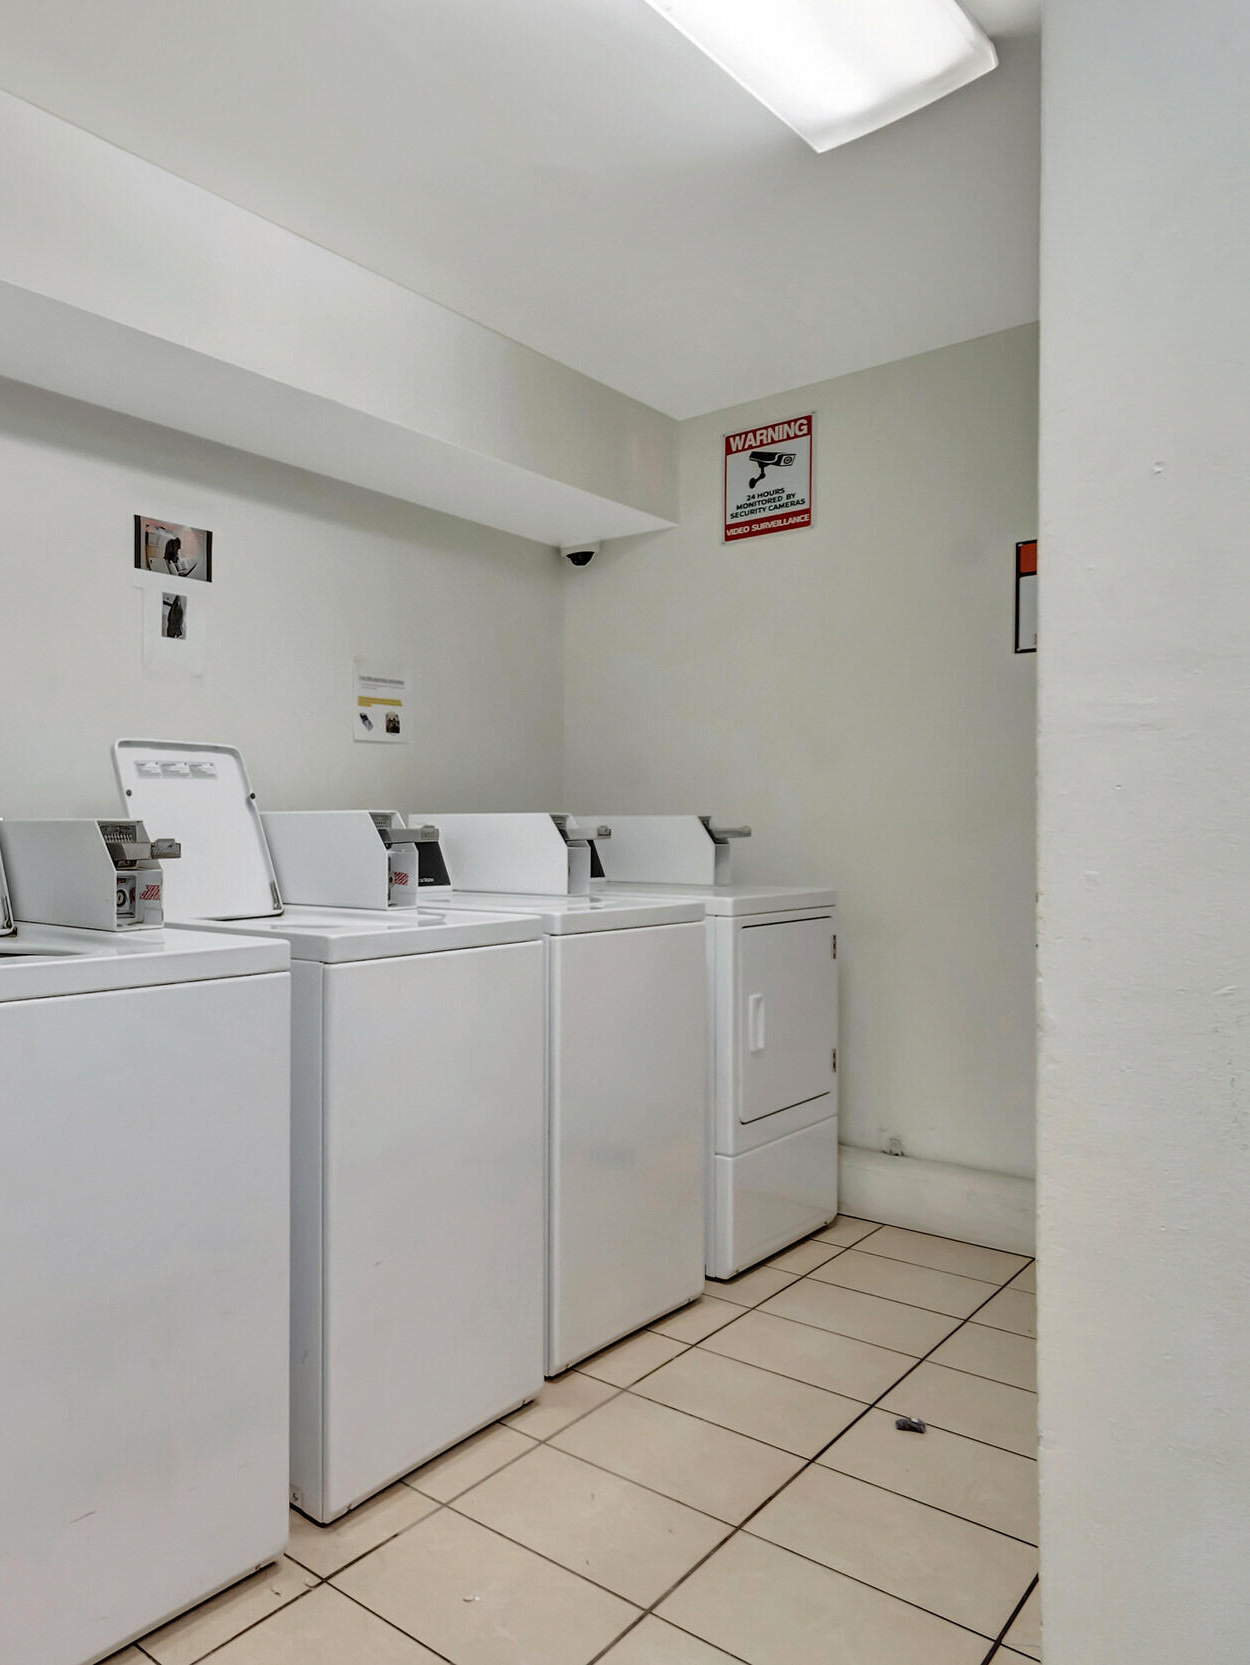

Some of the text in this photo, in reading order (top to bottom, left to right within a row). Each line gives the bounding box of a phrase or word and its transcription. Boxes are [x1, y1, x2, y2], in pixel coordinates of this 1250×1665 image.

[729, 419, 808, 452] WARNING
[736, 492, 796, 511] MONITORED BY
[746, 488, 785, 502] 24 HOURS
[730, 498, 806, 520] SECURITY CAMERAS
[726, 514, 810, 536] VIDEO SURVEILLANCE
